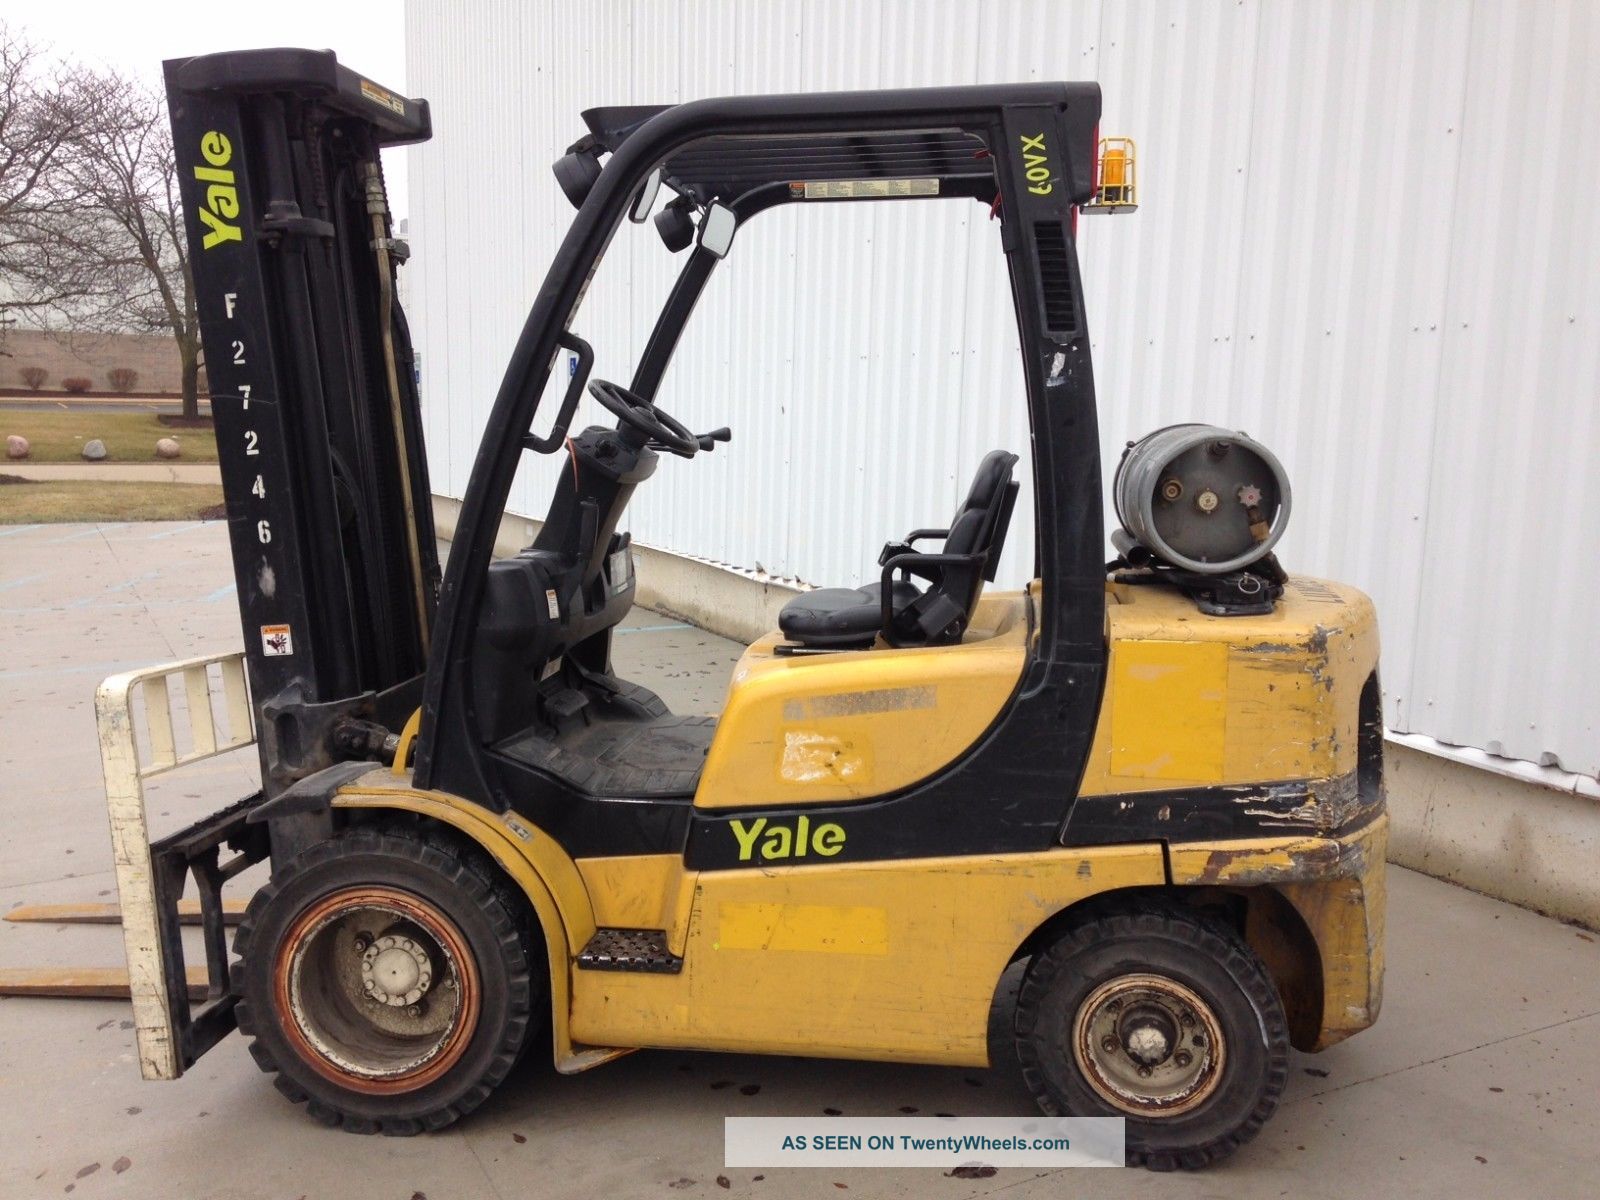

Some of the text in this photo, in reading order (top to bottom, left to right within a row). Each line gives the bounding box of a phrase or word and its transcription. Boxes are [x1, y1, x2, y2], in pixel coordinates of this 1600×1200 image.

[194, 130, 242, 249] Yale
[1020, 133, 1052, 195] 60VX
[729, 815, 847, 861] Yale
